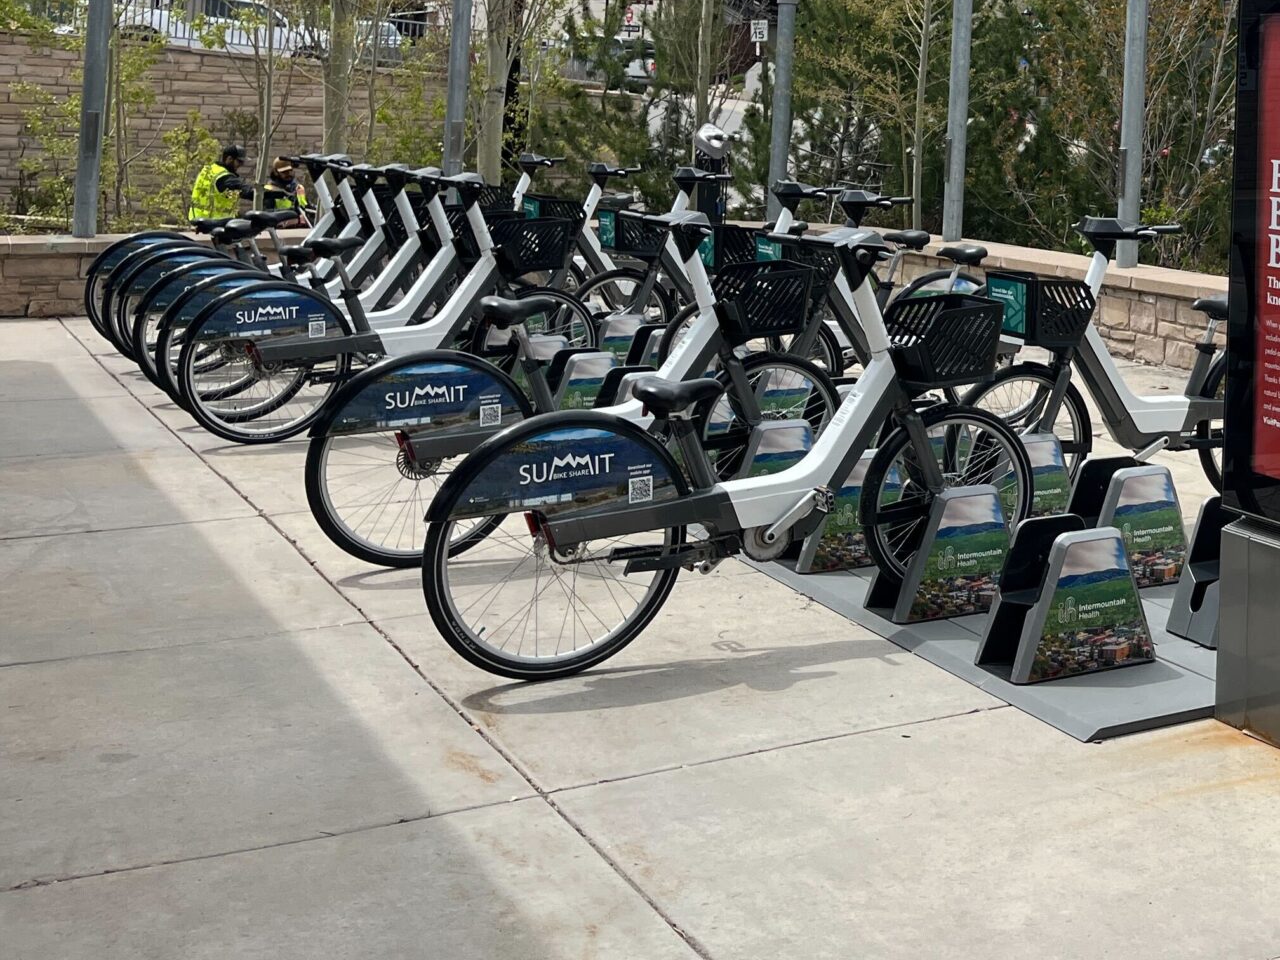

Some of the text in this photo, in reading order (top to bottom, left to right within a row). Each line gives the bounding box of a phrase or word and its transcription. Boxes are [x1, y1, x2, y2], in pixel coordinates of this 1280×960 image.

[236, 305, 299, 324] SUMMIT
[1266, 320, 1278, 328] When
[1264, 374, 1277, 384] Thanks
[385, 384, 468, 410] SUMMIT
[1264, 389, 1278, 398] natural
[428, 397, 446, 405] SHARE
[519, 452, 615, 485] SUMMIT
[553, 469, 590, 480] BIKE SHARE
[1133, 525, 1174, 536] Intermountain
[1133, 535, 1152, 543] Health
[957, 548, 1003, 560] Intermountain
[957, 559, 977, 567] Health
[1079, 598, 1126, 612] Intermountain
[1079, 611, 1100, 620] Health
